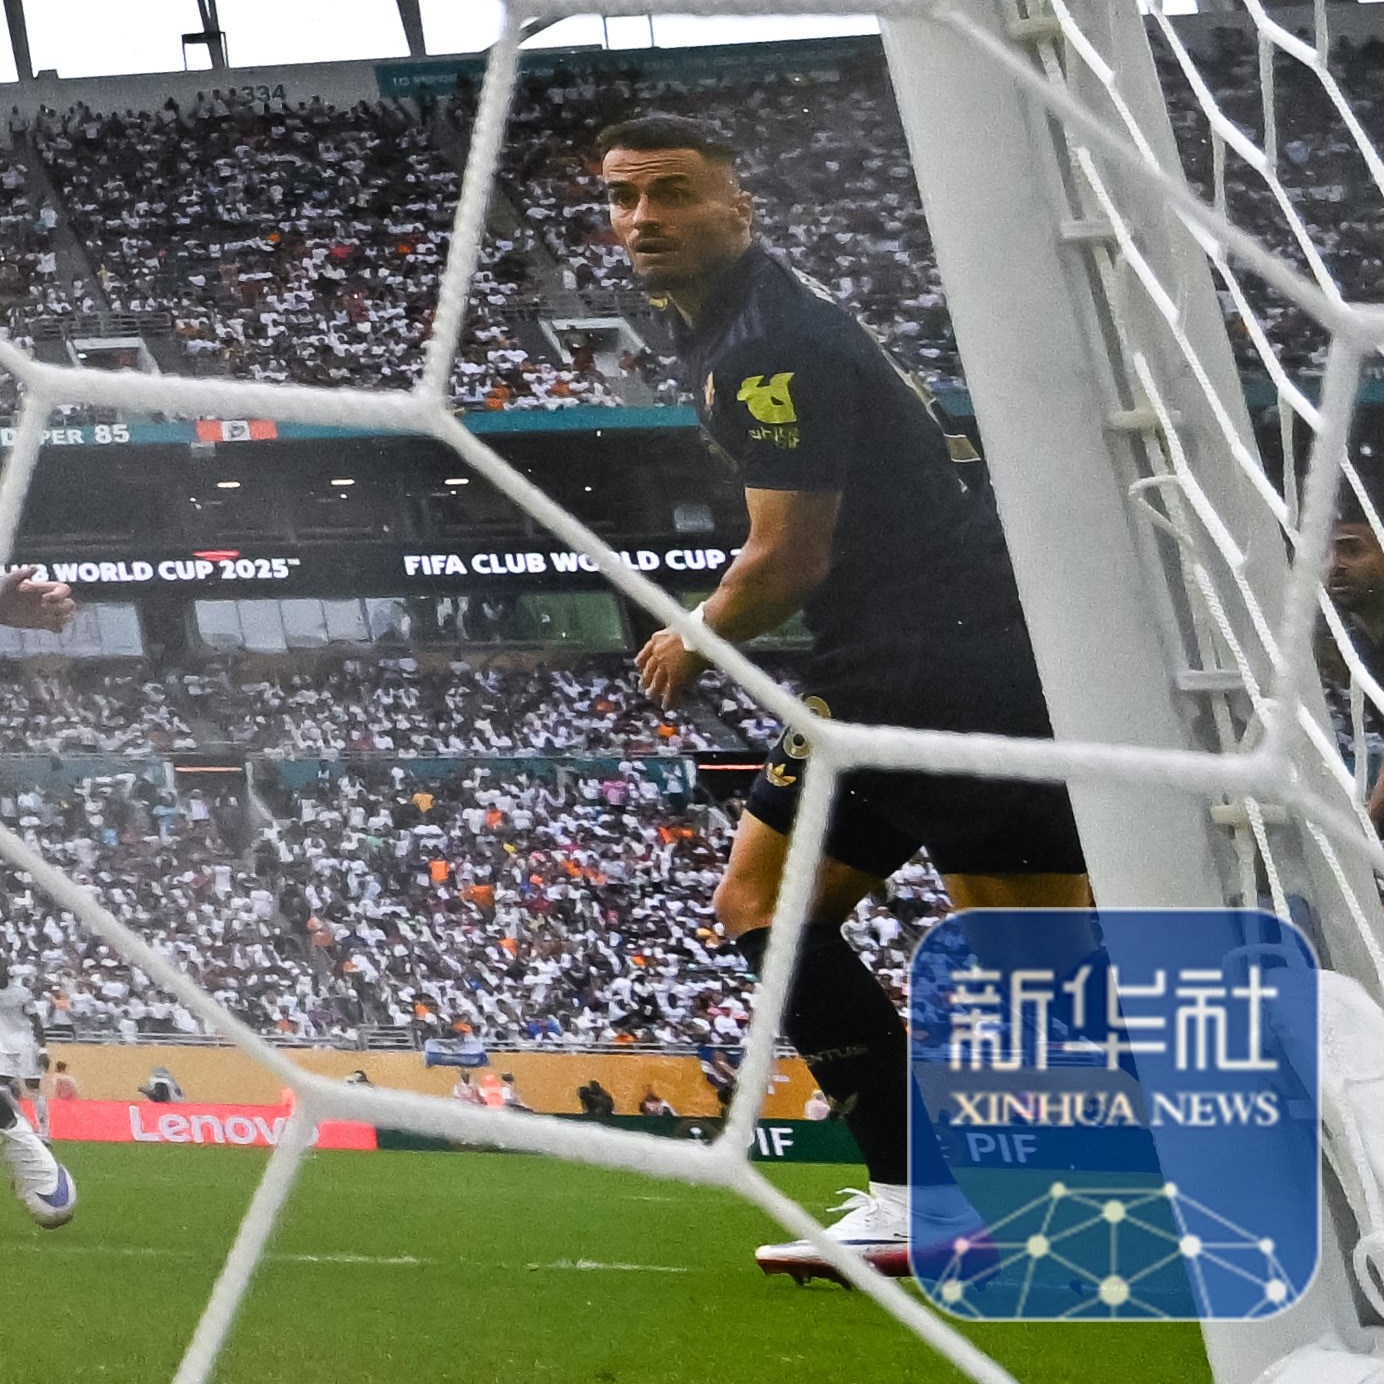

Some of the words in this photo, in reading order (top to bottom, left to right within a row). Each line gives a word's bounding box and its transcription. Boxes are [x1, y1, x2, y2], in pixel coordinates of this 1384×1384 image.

[94, 424, 130, 444] 85
[54, 561, 153, 582] WORLD
[158, 559, 213, 580] CUP
[404, 555, 468, 576] FIFA
[472, 553, 547, 574] CLUB
[665, 549, 726, 569] CUP
